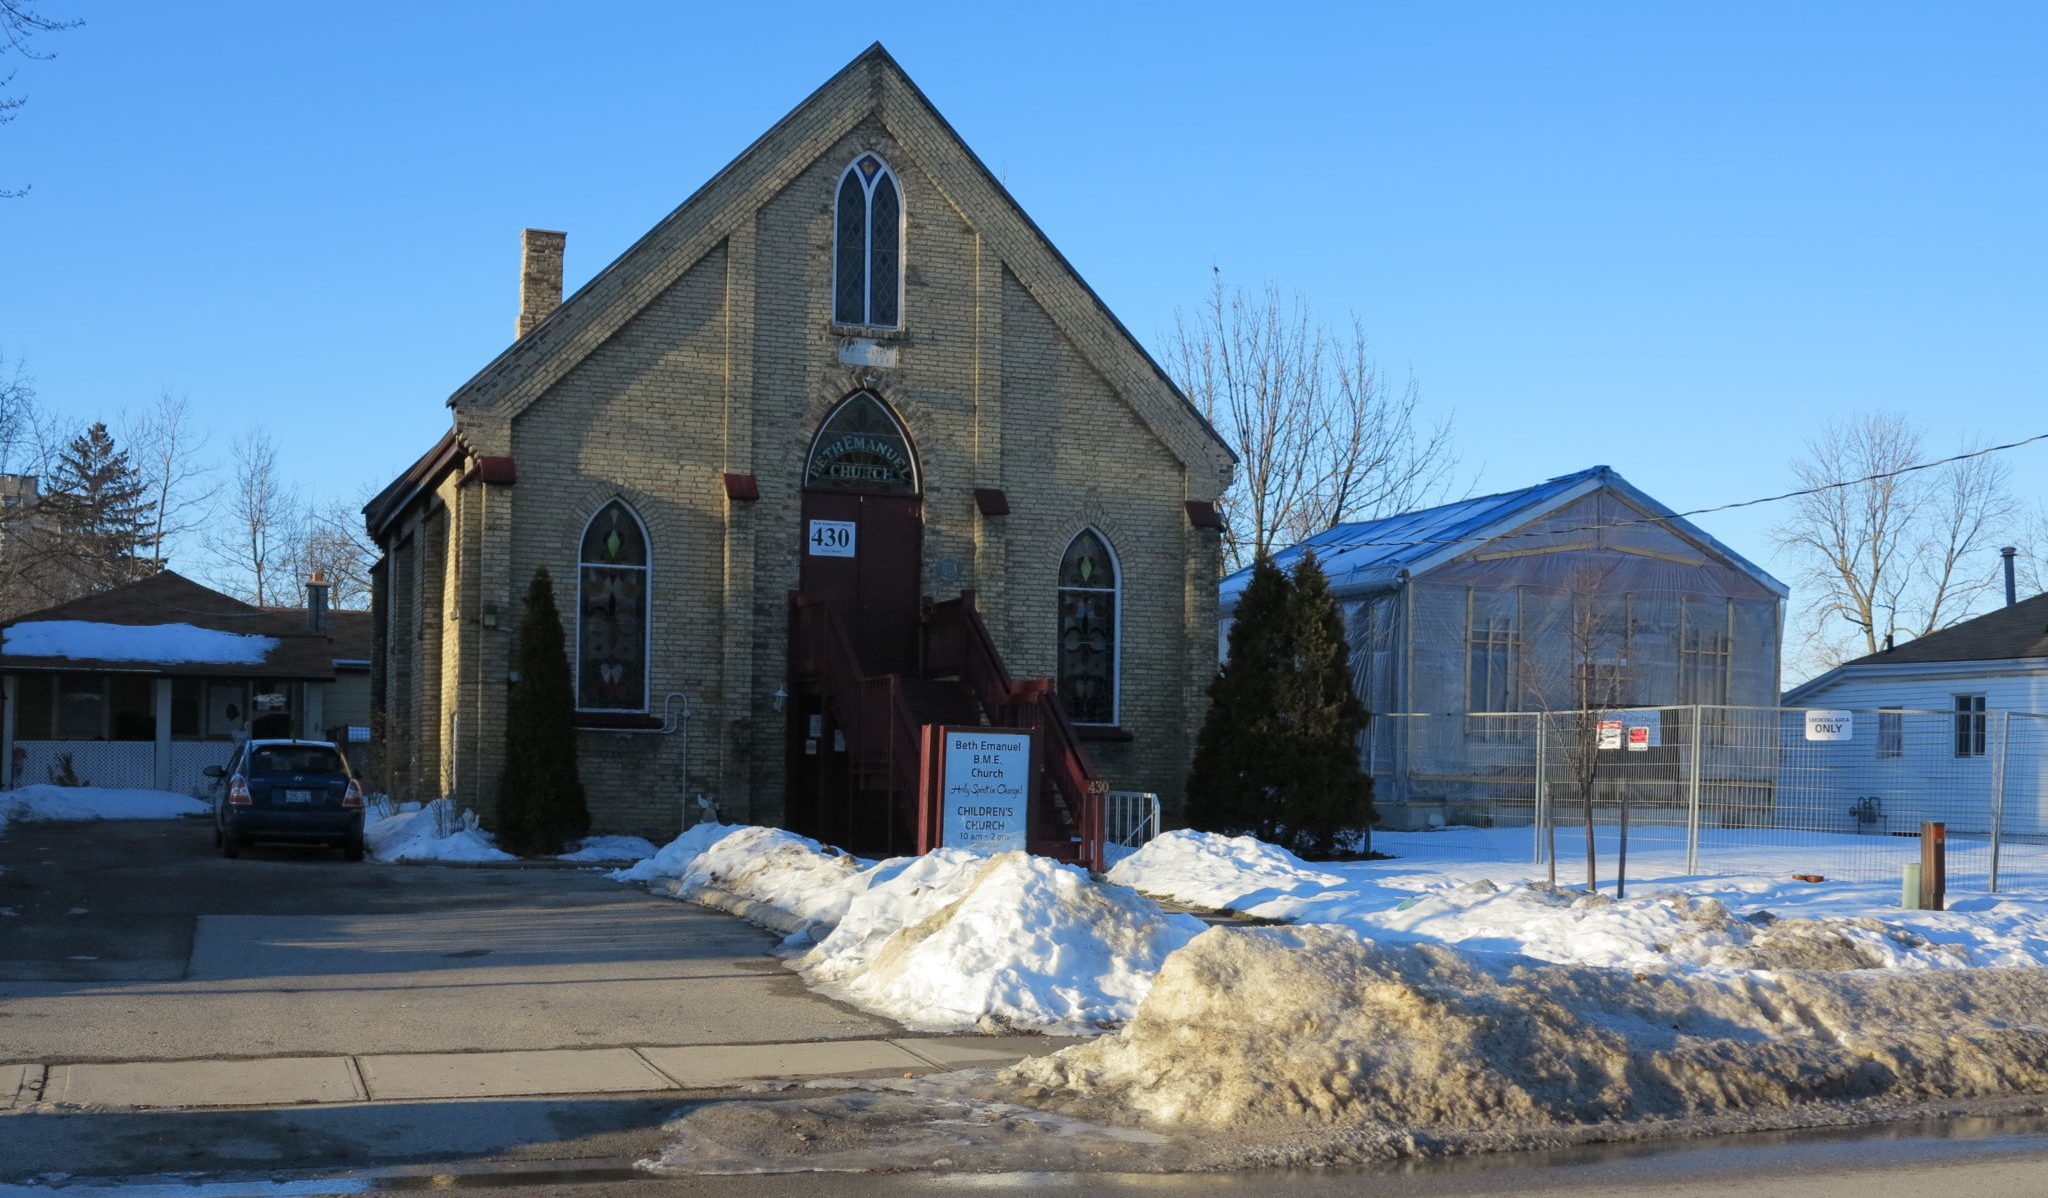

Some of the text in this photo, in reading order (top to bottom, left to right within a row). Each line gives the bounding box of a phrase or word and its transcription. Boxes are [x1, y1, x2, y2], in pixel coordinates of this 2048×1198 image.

[830, 465, 893, 480] CHURCH
[811, 527, 850, 548] 430
[1815, 724, 1842, 733] ONLY
[955, 740, 1021, 752] Beth Emanuel
[973, 754, 1002, 765] B.M.E.
[971, 768, 1004, 778] Church
[1087, 780, 1109, 794] 430
[957, 806, 1014, 817] CHILDREN'S
[965, 820, 1005, 831] CHURCH
[959, 832, 968, 840] 10
